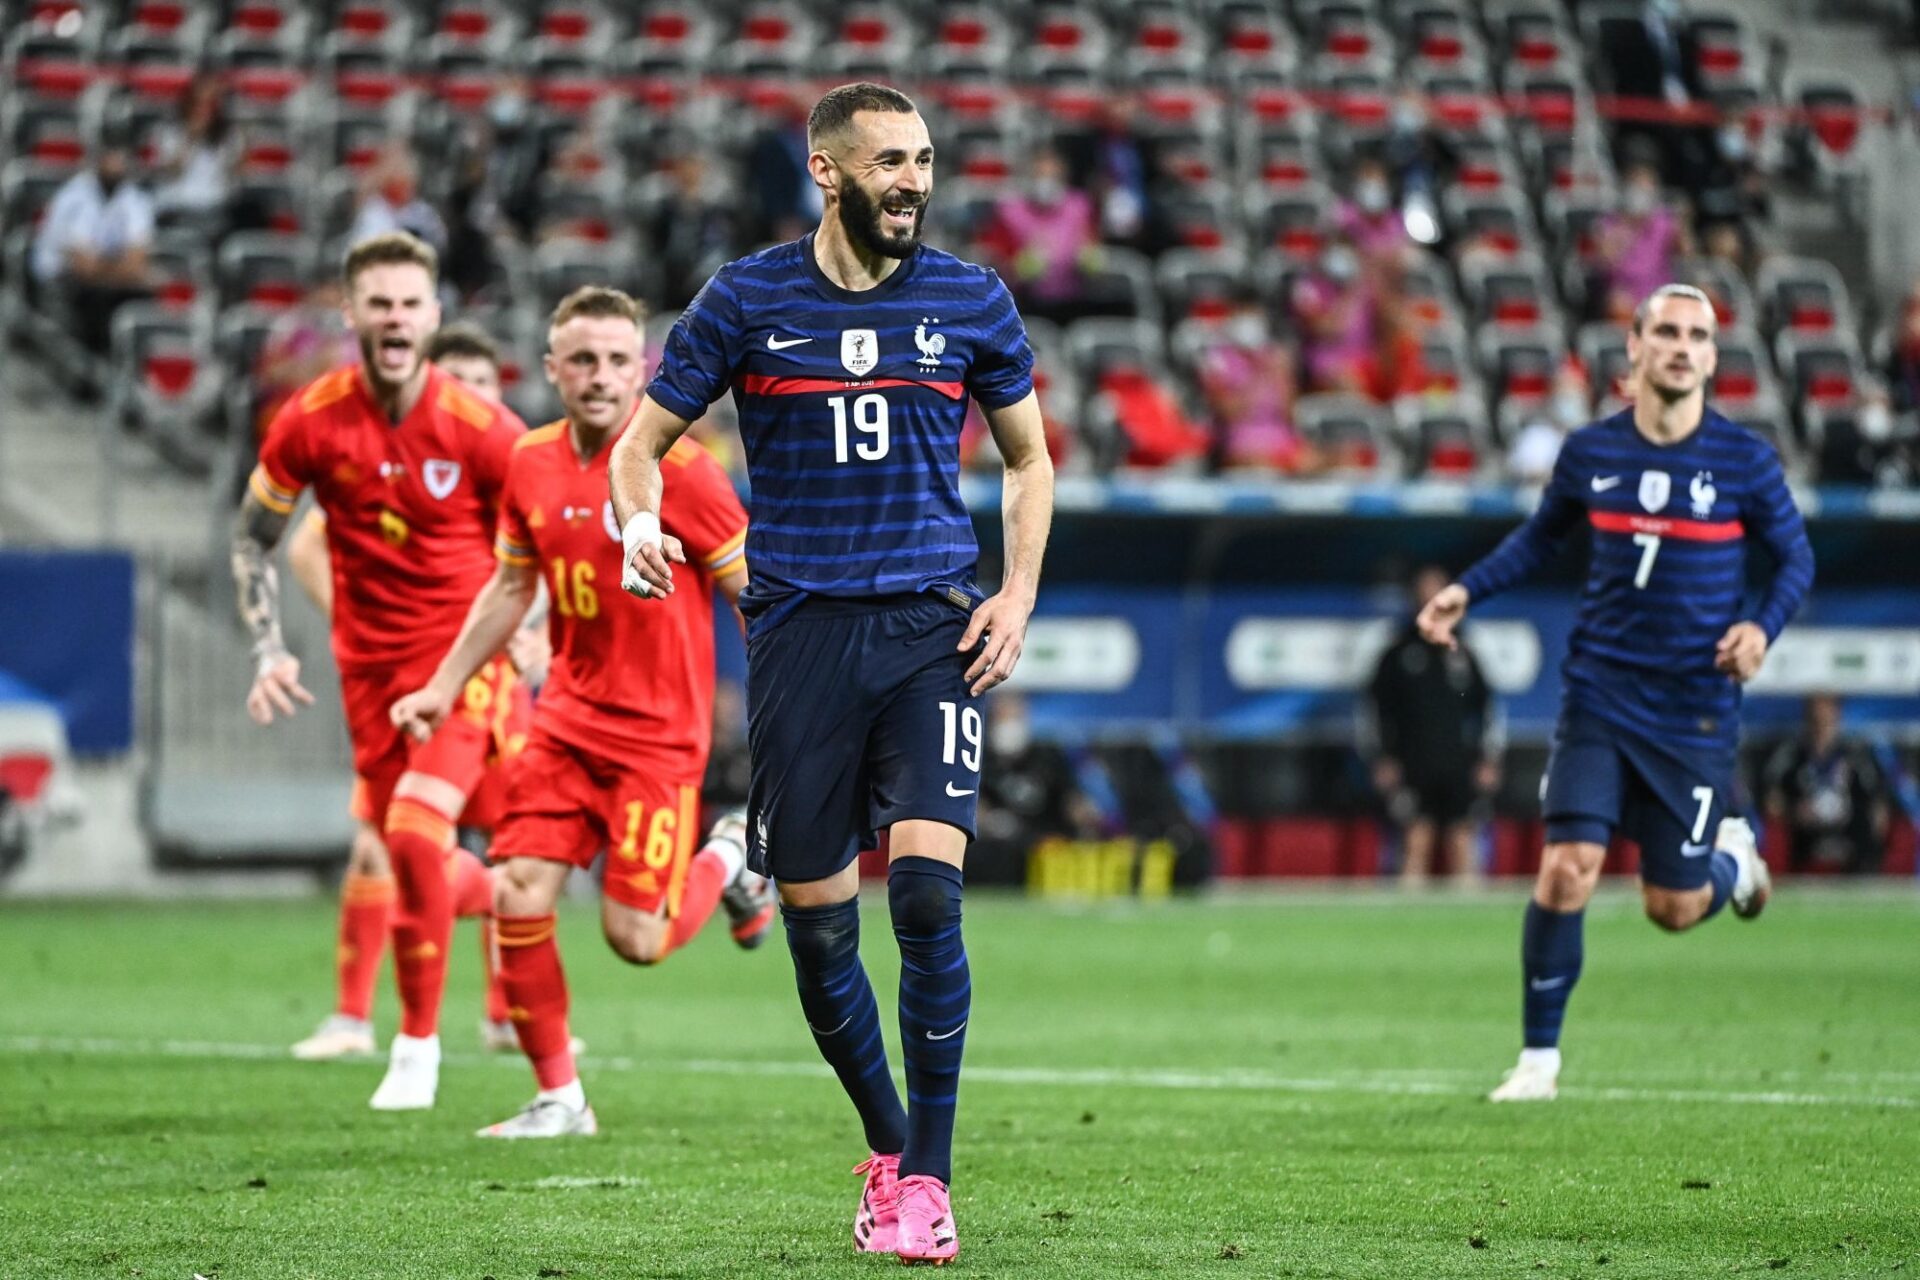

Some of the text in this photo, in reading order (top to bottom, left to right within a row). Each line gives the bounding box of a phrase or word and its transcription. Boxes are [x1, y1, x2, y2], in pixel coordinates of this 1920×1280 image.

[827, 393, 890, 463] 19
[551, 556, 598, 618] 16
[1633, 532, 1661, 589] 7
[939, 701, 982, 773] 19
[619, 800, 676, 870] 16
[1692, 786, 1713, 843] 7
